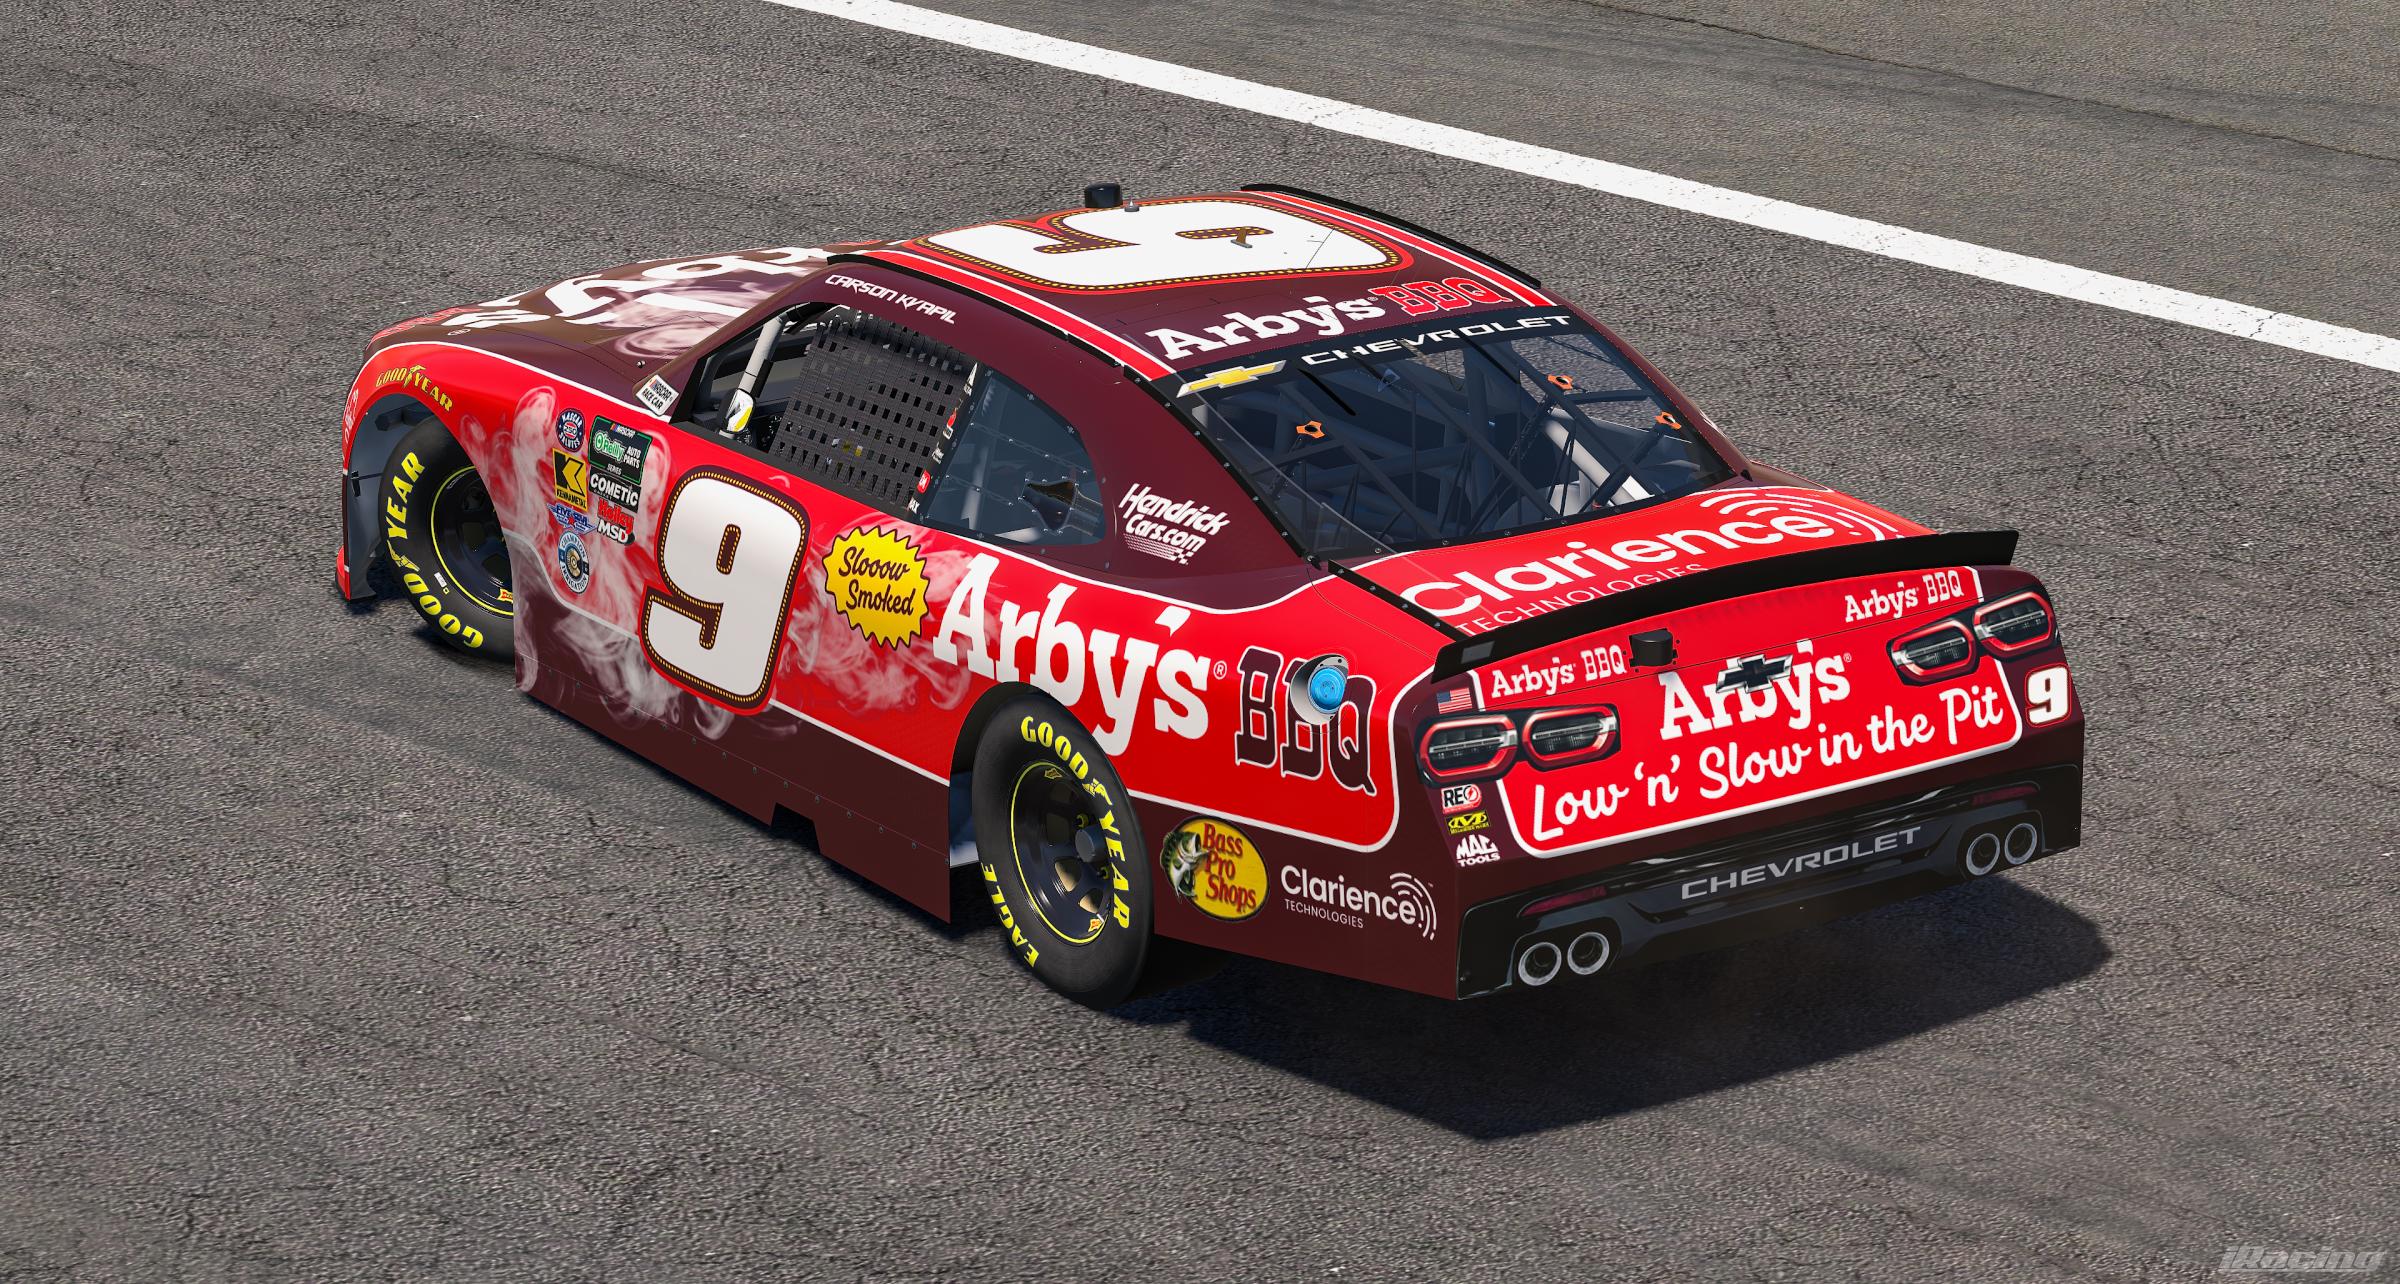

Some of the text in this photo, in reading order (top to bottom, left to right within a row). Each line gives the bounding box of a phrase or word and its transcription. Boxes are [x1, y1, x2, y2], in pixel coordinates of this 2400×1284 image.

[914, 200, 1404, 291] 9
[824, 274, 957, 325] CARSON KVAPIL
[1145, 277, 1514, 361] Arby's BBQ
[1301, 315, 1571, 366] CHEVROLET
[650, 397, 664, 410] CAR
[594, 431, 626, 462] O'Reilly
[623, 454, 641, 469] PARTS
[626, 445, 641, 459] AUTO
[606, 463, 622, 476] SERIES
[590, 473, 639, 507] COMETIC
[1118, 483, 1230, 535] Hendrick
[597, 497, 634, 535] Holley
[597, 518, 629, 544] MSD
[1125, 513, 1207, 552] Cars.com
[838, 546, 911, 581] Slooow
[1400, 512, 1835, 618] Clarience
[643, 470, 807, 704] 9
[845, 579, 917, 616] Smoked
[1844, 570, 1965, 623] Arby's BBQ
[932, 552, 1211, 756] Arby's
[1491, 645, 1628, 699] Arby's BBQ
[1658, 638, 1851, 741] Arby's
[2025, 663, 2070, 727] 9
[1533, 784, 1630, 842] Low
[1699, 741, 1812, 800] Slow
[1817, 723, 1863, 767] in
[1866, 705, 1936, 754] the
[1938, 685, 2004, 746] Pit
[1202, 822, 1244, 857] Bass
[1455, 833, 1499, 860] MAC
[1205, 850, 1237, 880] Pro
[1457, 852, 1501, 868] TOOLS
[1680, 826, 1921, 900] CHEVROLET
[1205, 875, 1257, 914] Shops
[1280, 864, 1417, 926] Clarience
[1284, 898, 1364, 929] TECHNOLOGIES
[980, 861, 1040, 968] EAGLE
